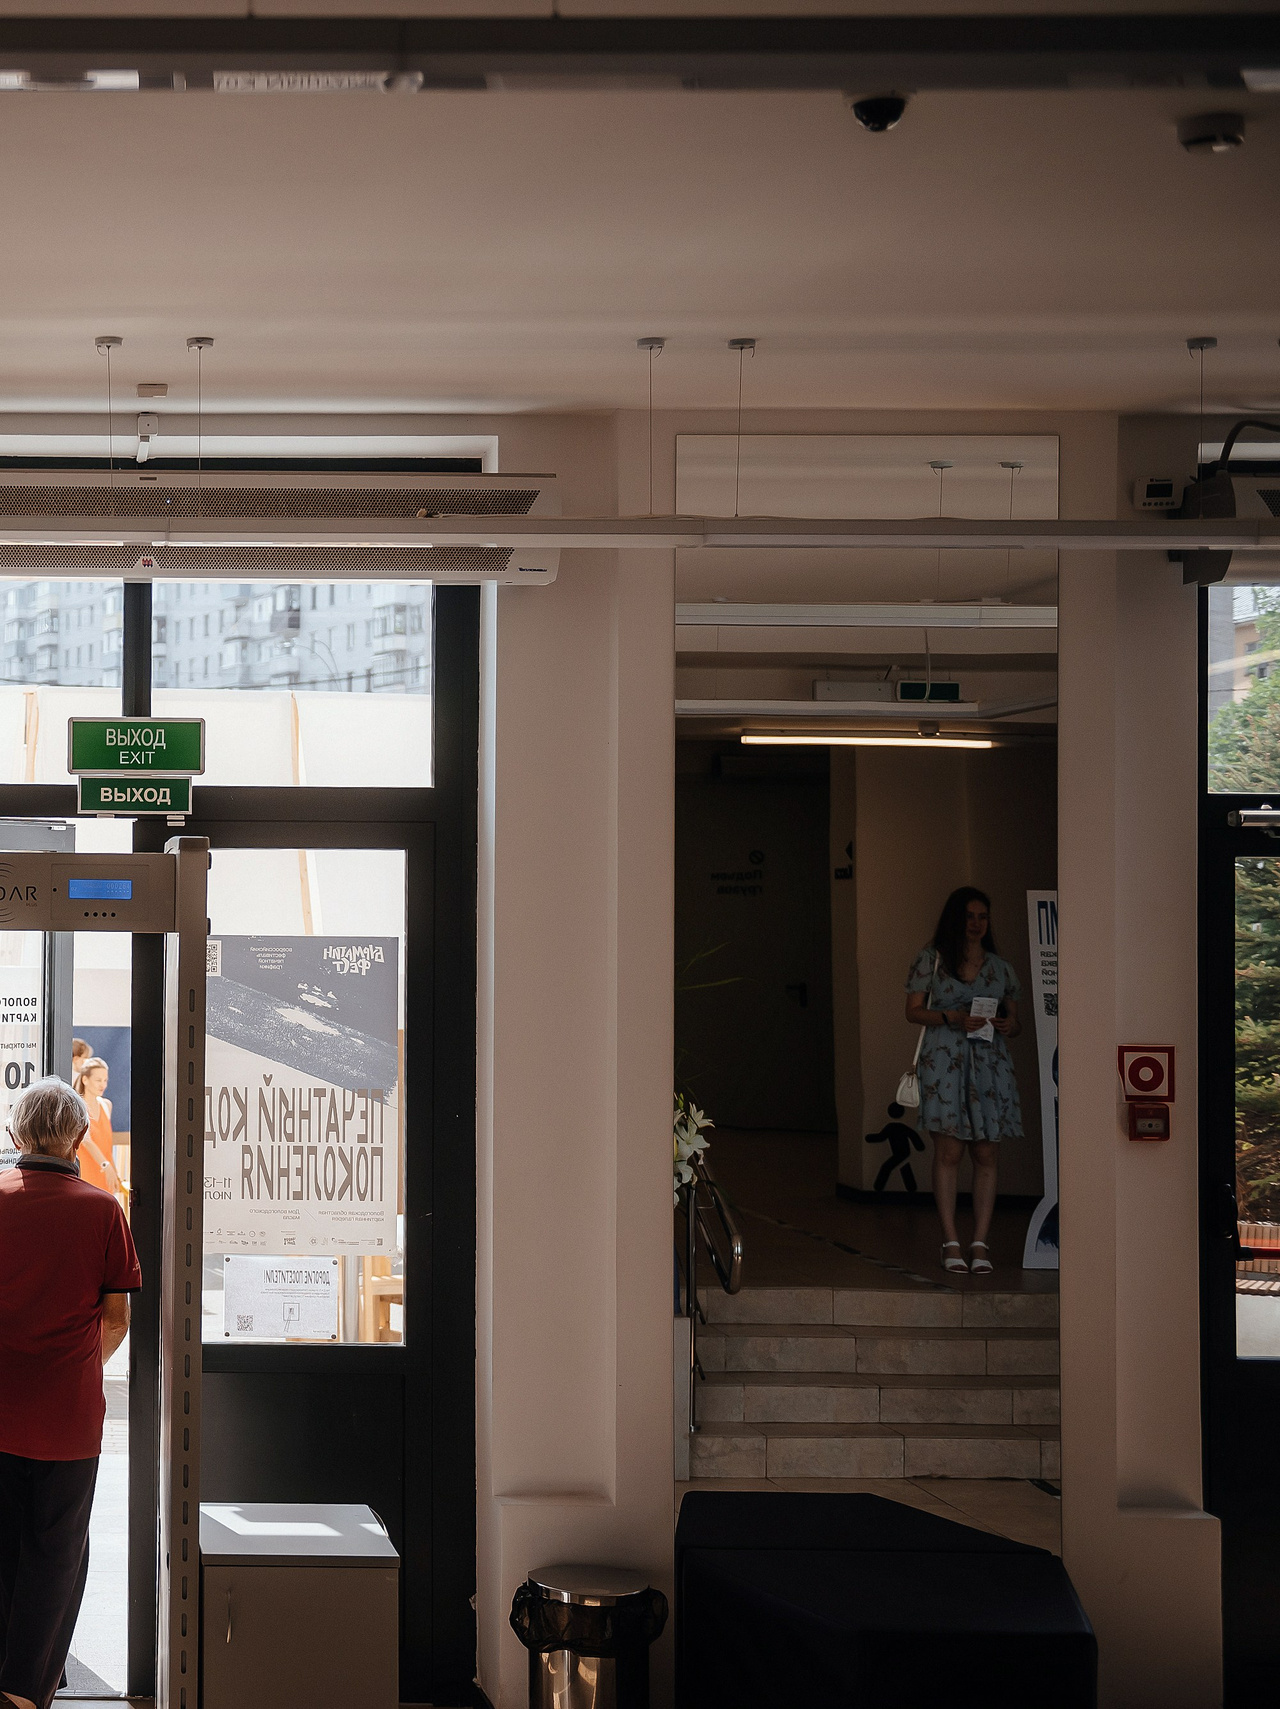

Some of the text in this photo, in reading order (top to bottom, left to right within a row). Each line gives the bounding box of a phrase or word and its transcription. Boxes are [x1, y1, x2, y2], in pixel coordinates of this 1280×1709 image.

[106, 728, 166, 750] ВЫХОД
[120, 751, 155, 764] EXIT
[100, 787, 171, 805] ВЫХОД
